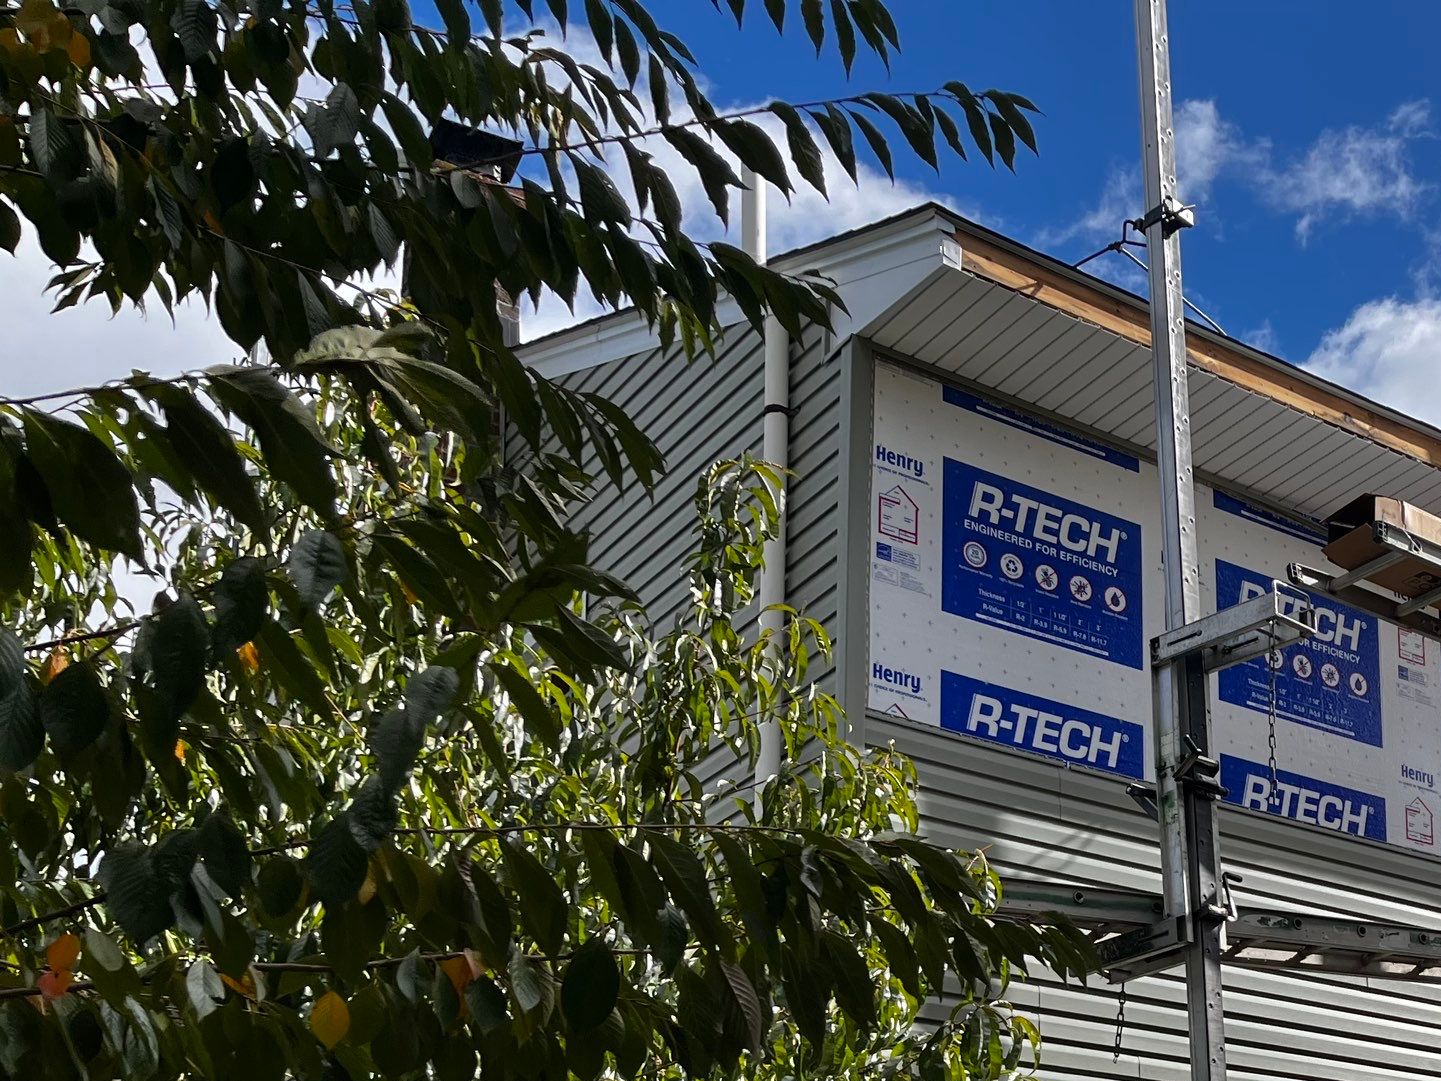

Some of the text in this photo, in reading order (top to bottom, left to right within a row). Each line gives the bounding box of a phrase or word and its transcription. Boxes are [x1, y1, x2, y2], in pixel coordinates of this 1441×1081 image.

[876, 443, 923, 477] Henry
[964, 519, 1118, 577] ENGINEERED FOR EFFICIENCY
[1312, 642, 1360, 664] EFFICIENCY
[873, 662, 920, 693] Henry
[1401, 764, 1434, 788] Henry
